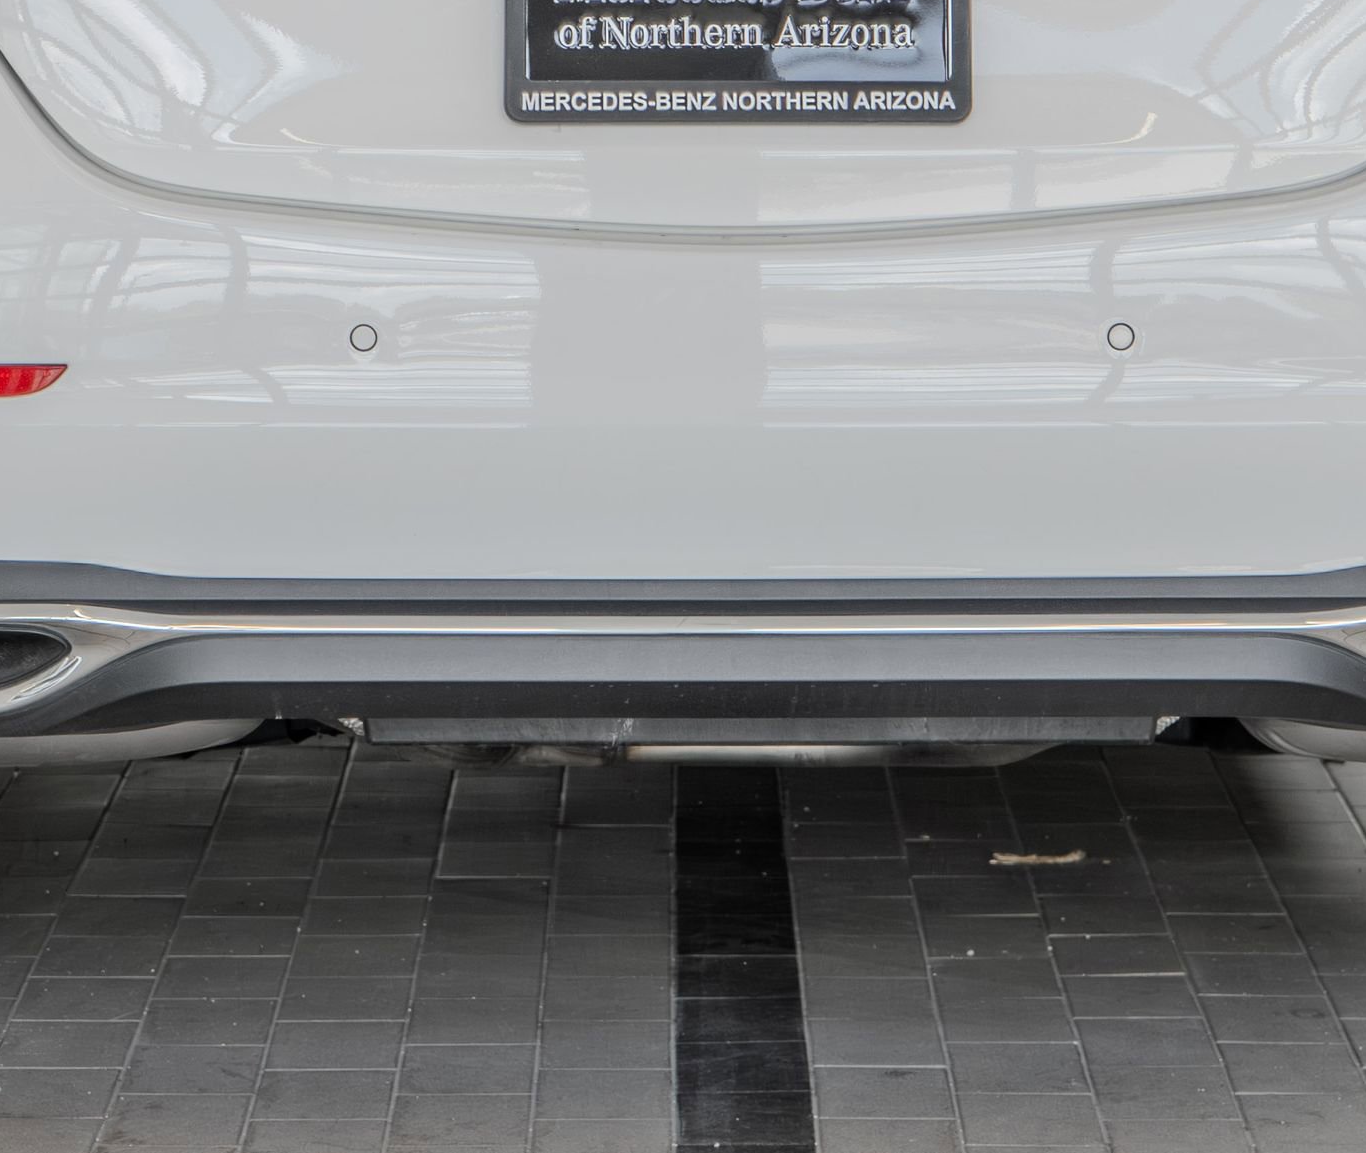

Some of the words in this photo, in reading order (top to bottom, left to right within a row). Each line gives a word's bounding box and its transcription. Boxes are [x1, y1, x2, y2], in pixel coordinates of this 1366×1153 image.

[553, 16, 597, 49] of
[599, 16, 764, 49] Northern
[774, 16, 915, 49] Arizona
[521, 91, 716, 112] MERCEDES-BENZ
[722, 91, 848, 112] NORTHERN
[853, 91, 956, 111] ARIZONA
